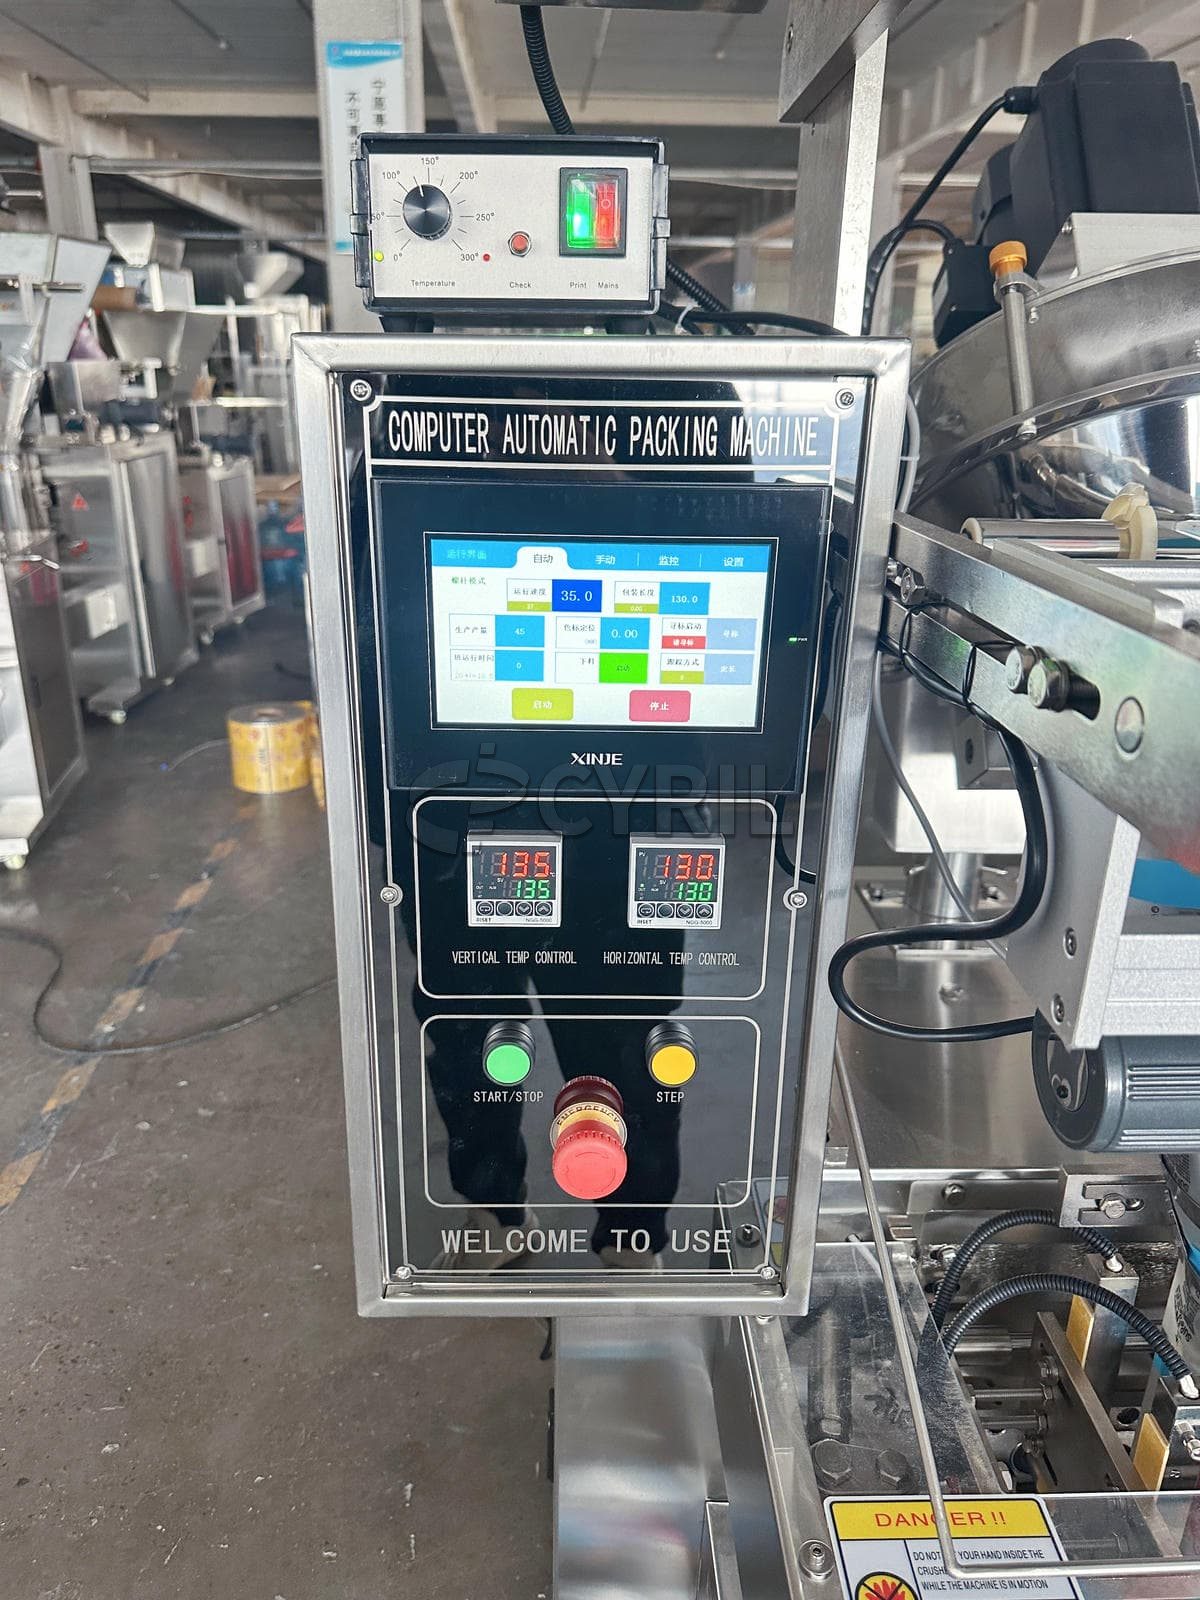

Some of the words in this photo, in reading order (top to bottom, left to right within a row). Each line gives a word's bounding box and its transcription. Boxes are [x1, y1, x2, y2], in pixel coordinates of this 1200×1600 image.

[421, 156, 440, 166] 150°
[382, 171, 401, 180] 100°
[459, 170, 479, 180] 200°
[475, 212, 495, 222] 250°
[393, 252, 403, 262] 0°
[460, 252, 479, 262] 300°
[410, 279, 456, 289] Temperature
[509, 281, 532, 289] Check
[569, 281, 587, 289] Print
[388, 411, 490, 454] COMPUTER
[502, 413, 617, 456] AUTOMATIC
[629, 415, 718, 457] PACKING
[729, 416, 819, 457] MACHINE
[533, 553, 554, 565] 自动
[595, 554, 616, 566] 手动
[658, 555, 680, 567] 监控
[723, 557, 744, 568] 设置
[561, 590, 593, 602] 35.0
[611, 629, 639, 639] 0.00
[533, 700, 553, 710] 启动
[649, 701, 670, 712] 停止
[570, 752, 624, 766] XINJE
[500, 851, 551, 878] 135
[663, 854, 715, 880] 130
[516, 879, 550, 899] 135
[678, 881, 713, 901] 130
[452, 950, 500, 965] VERTICAL
[505, 951, 531, 965] TEMP
[535, 951, 577, 965] CONTROL
[603, 951, 663, 966] HORIZONTAL
[669, 952, 693, 966] TEMP
[698, 952, 740, 967] CONTROL
[473, 1090, 544, 1103] START/STOP
[656, 1091, 685, 1103] STEP
[441, 1229, 588, 1254] WELCOME
[610, 1228, 651, 1254] TO
[671, 1229, 732, 1254] USE
[913, 1551, 926, 1561] DO
[926, 1551, 941, 1561] NOT
[959, 1551, 980, 1560] YOUR
[981, 1550, 1002, 1560] HAND
[1003, 1550, 1029, 1559] INSIDE
[1029, 1549, 1046, 1559] THE
[921, 1581, 947, 1591] WHILE
[947, 1580, 965, 1590] THE
[964, 1580, 1000, 1590] MACHINE
[1000, 1580, 1008, 1589] IS
[1008, 1580, 1017, 1589] IN
[1018, 1579, 1049, 1589] MOTION
